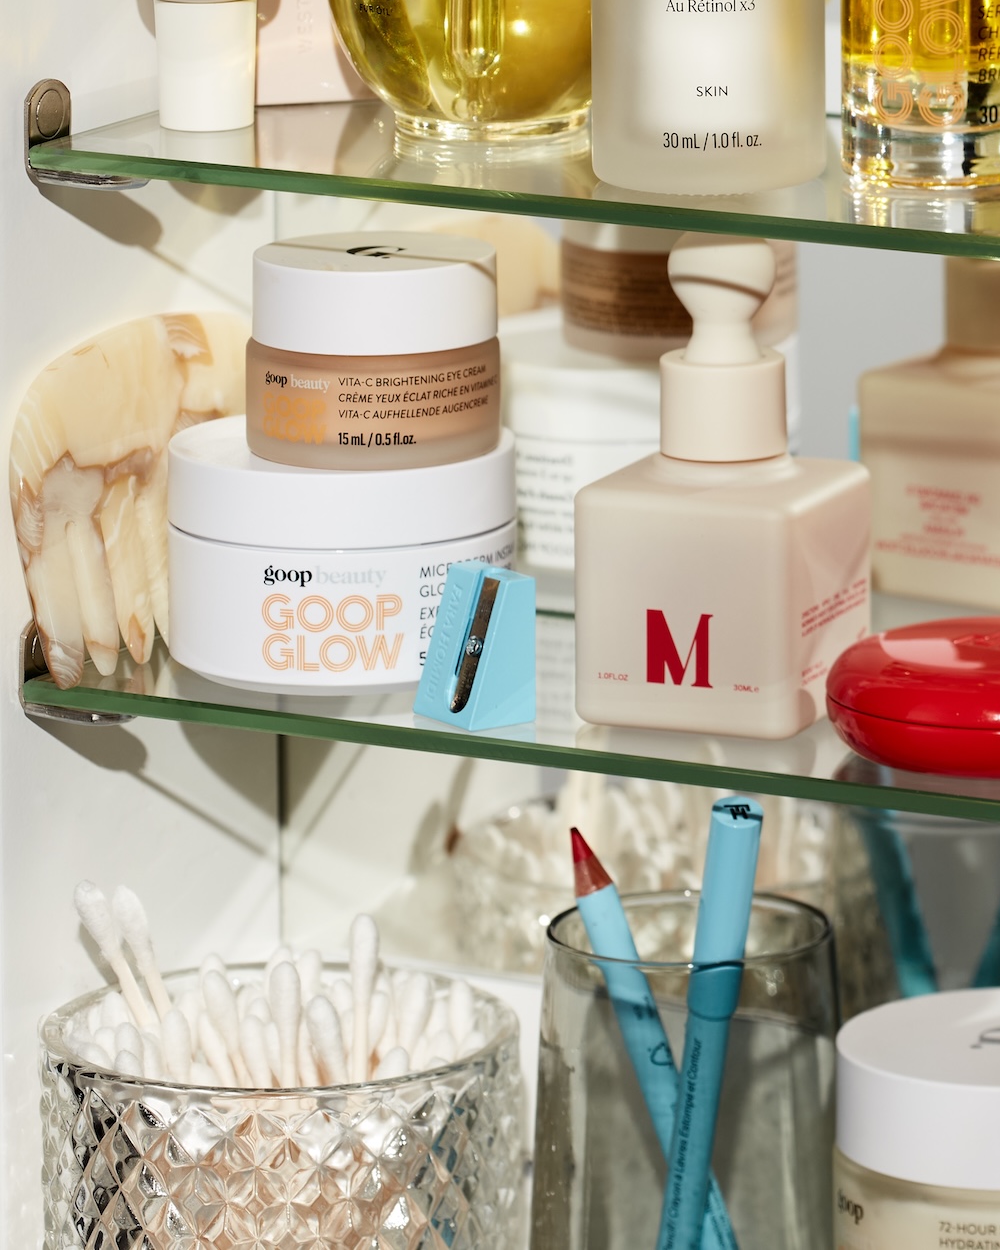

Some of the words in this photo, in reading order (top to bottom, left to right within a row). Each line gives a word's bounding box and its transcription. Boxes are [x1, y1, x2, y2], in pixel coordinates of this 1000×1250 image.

[666, 0, 684, 13] Au
[696, 85, 728, 97] SKIN
[265, 370, 288, 388] goop
[290, 374, 331, 394] beauty
[338, 377, 373, 388] VITA-C
[375, 373, 445, 387] BRIGHTENING
[447, 370, 462, 381] EYE
[463, 364, 487, 378] CREAM
[338, 392, 373, 403] CRÈME
[376, 393, 401, 403] YEUX
[403, 390, 431, 402] ÉCLAT
[433, 388, 458, 399] RICHE
[459, 386, 470, 396] EN
[263, 565, 312, 587] goop
[316, 566, 387, 588] beauty
[261, 593, 402, 633] GOOP
[262, 632, 405, 672] GLOW
[646, 608, 713, 688] M
[938, 1221, 997, 1236] 72-HOUR
